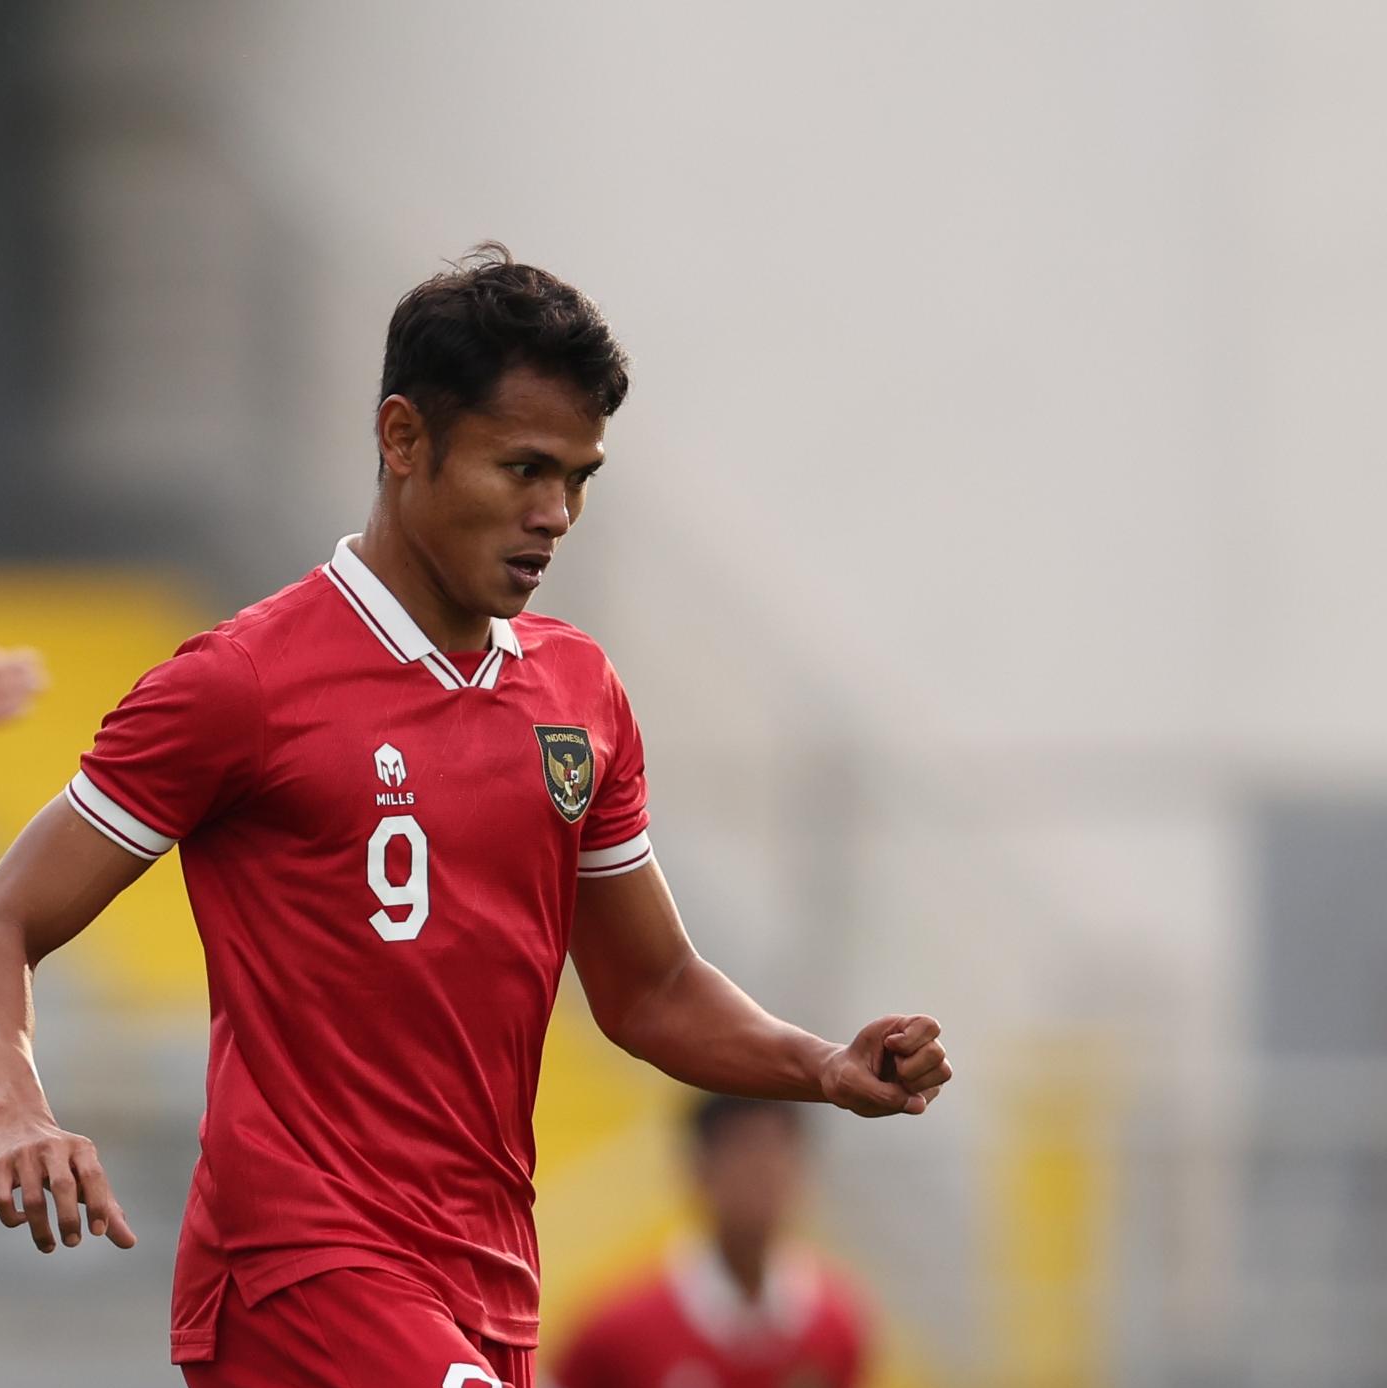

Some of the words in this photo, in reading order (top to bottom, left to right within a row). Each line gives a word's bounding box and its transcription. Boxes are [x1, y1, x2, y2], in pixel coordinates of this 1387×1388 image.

[544, 733, 586, 746] INDONESIA
[375, 792, 415, 806] MILLS
[367, 814, 430, 942] 9
